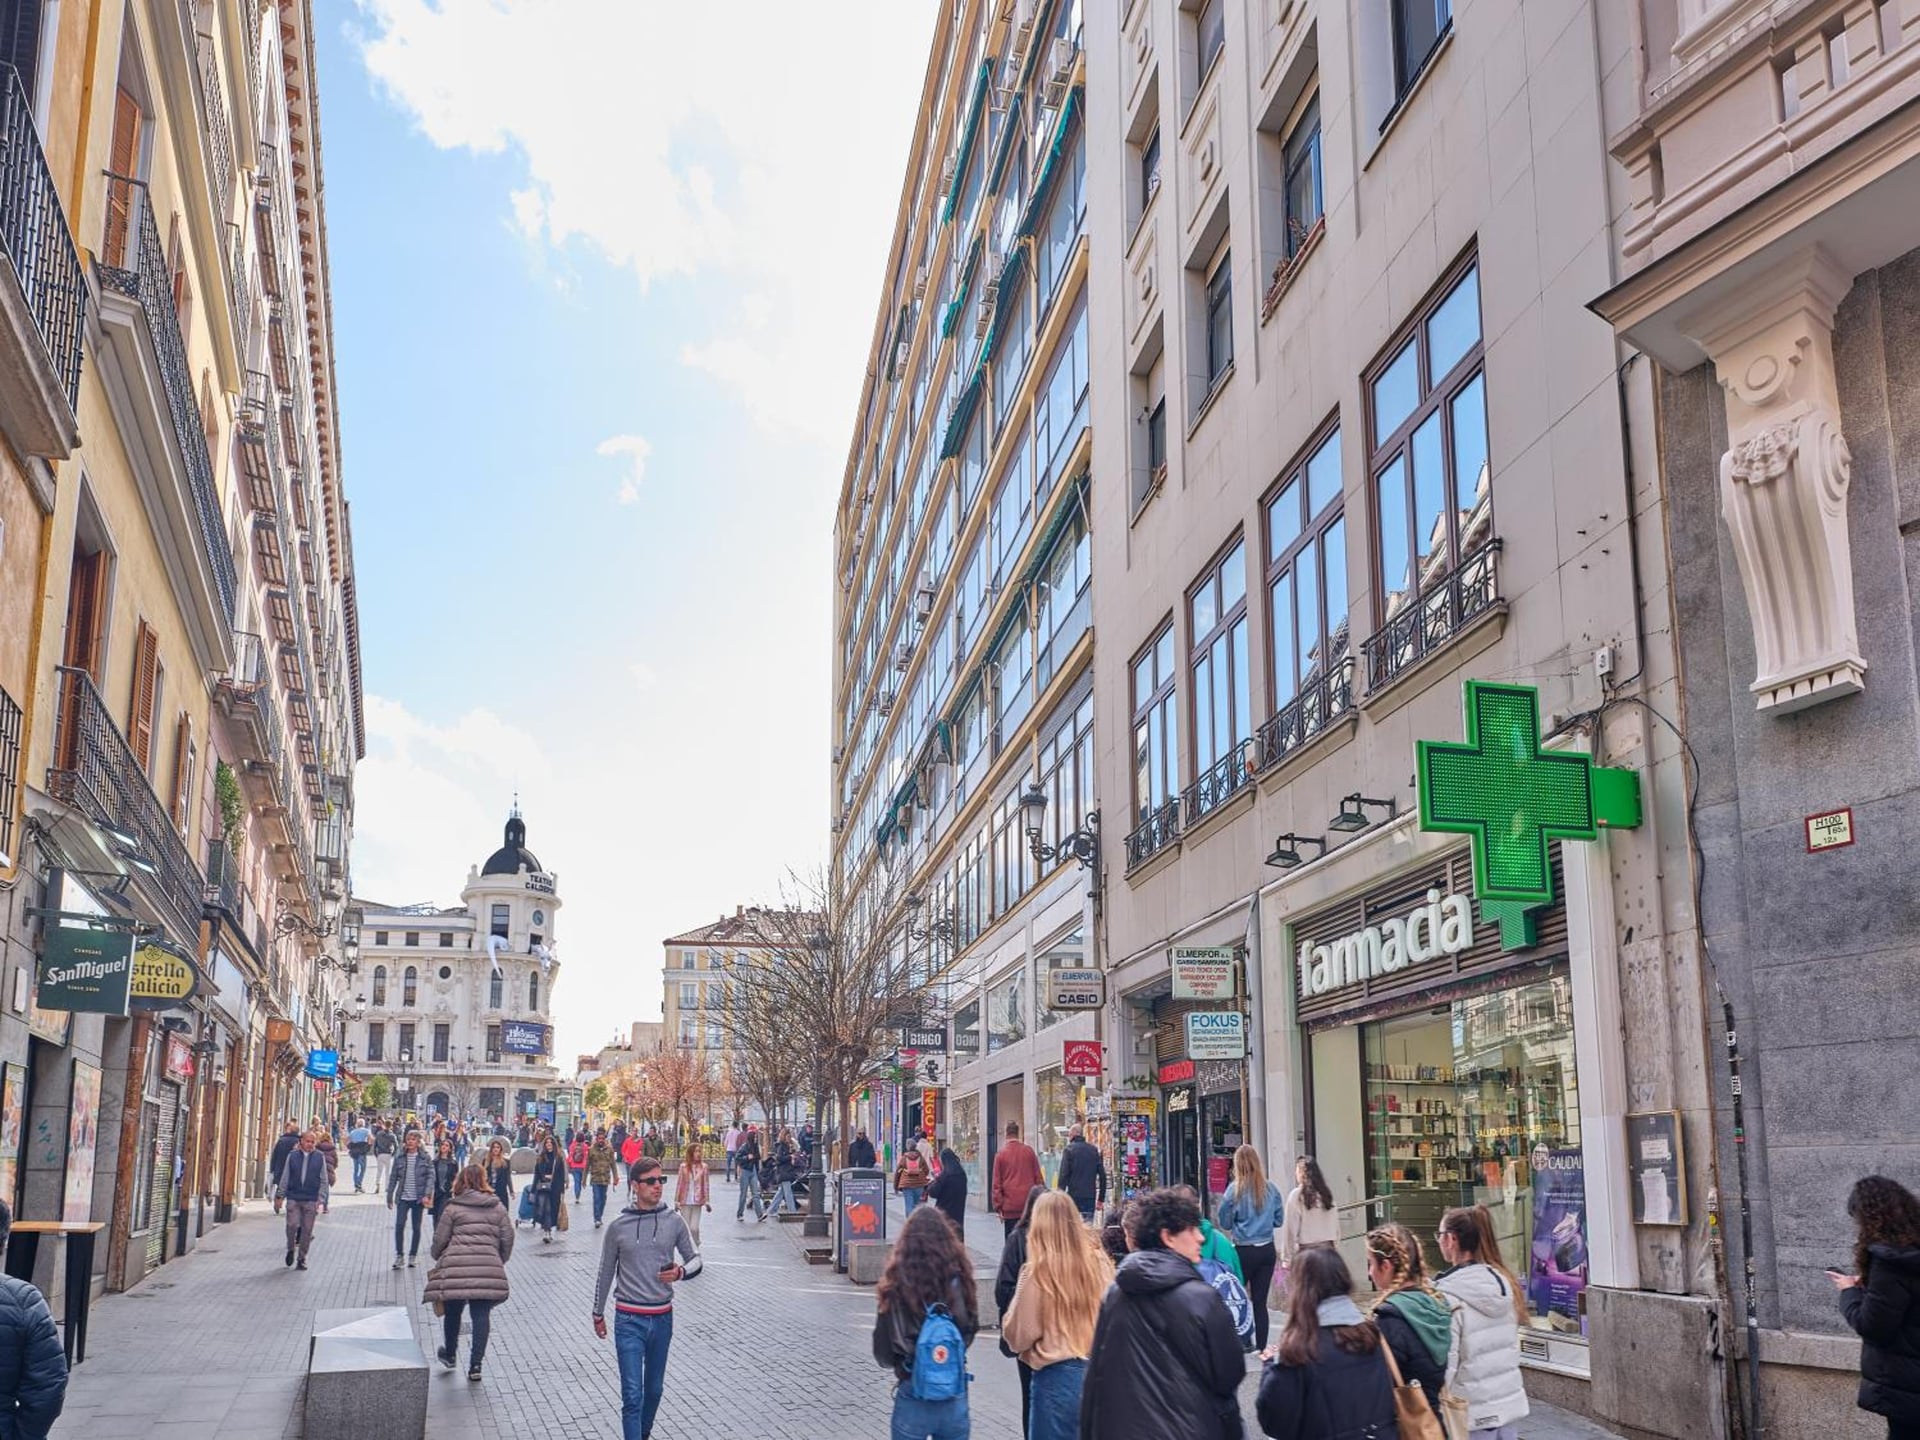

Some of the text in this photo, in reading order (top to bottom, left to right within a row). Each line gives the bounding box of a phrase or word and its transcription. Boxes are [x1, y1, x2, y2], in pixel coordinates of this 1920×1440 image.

[1816, 815, 1841, 827] H100
[1301, 888, 1474, 998] farmacia
[1176, 950, 1220, 958] ELMERFOR
[133, 961, 186, 979] strella
[131, 977, 181, 995] alicia
[1058, 994, 1098, 1004] CASIO
[1191, 1014, 1239, 1027] FOKUS
[910, 1033, 942, 1046] BINGO
